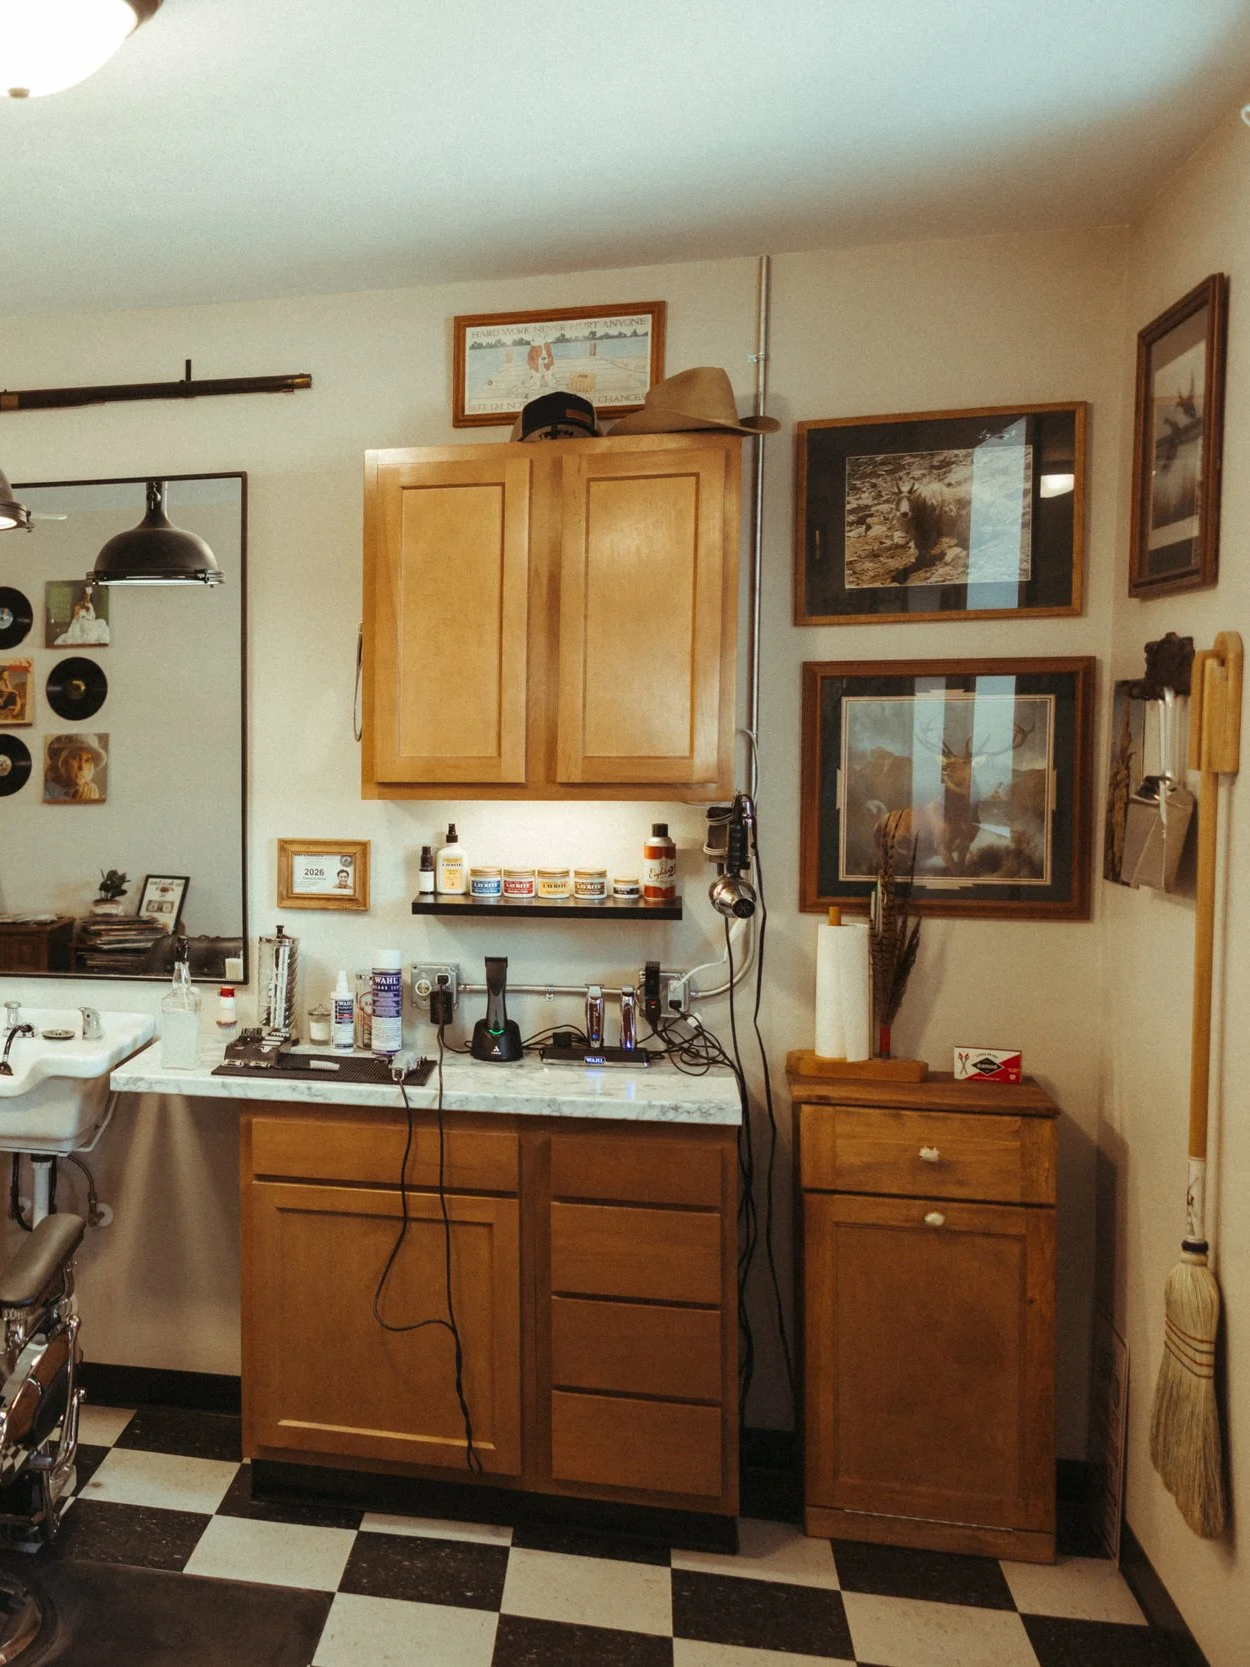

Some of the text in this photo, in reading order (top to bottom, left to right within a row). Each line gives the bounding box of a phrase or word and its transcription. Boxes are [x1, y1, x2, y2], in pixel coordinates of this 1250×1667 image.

[503, 326, 530, 337] WORK
[603, 317, 646, 329] ANYONE
[304, 868, 325, 876] 2026
[375, 976, 398, 985] WAHL
